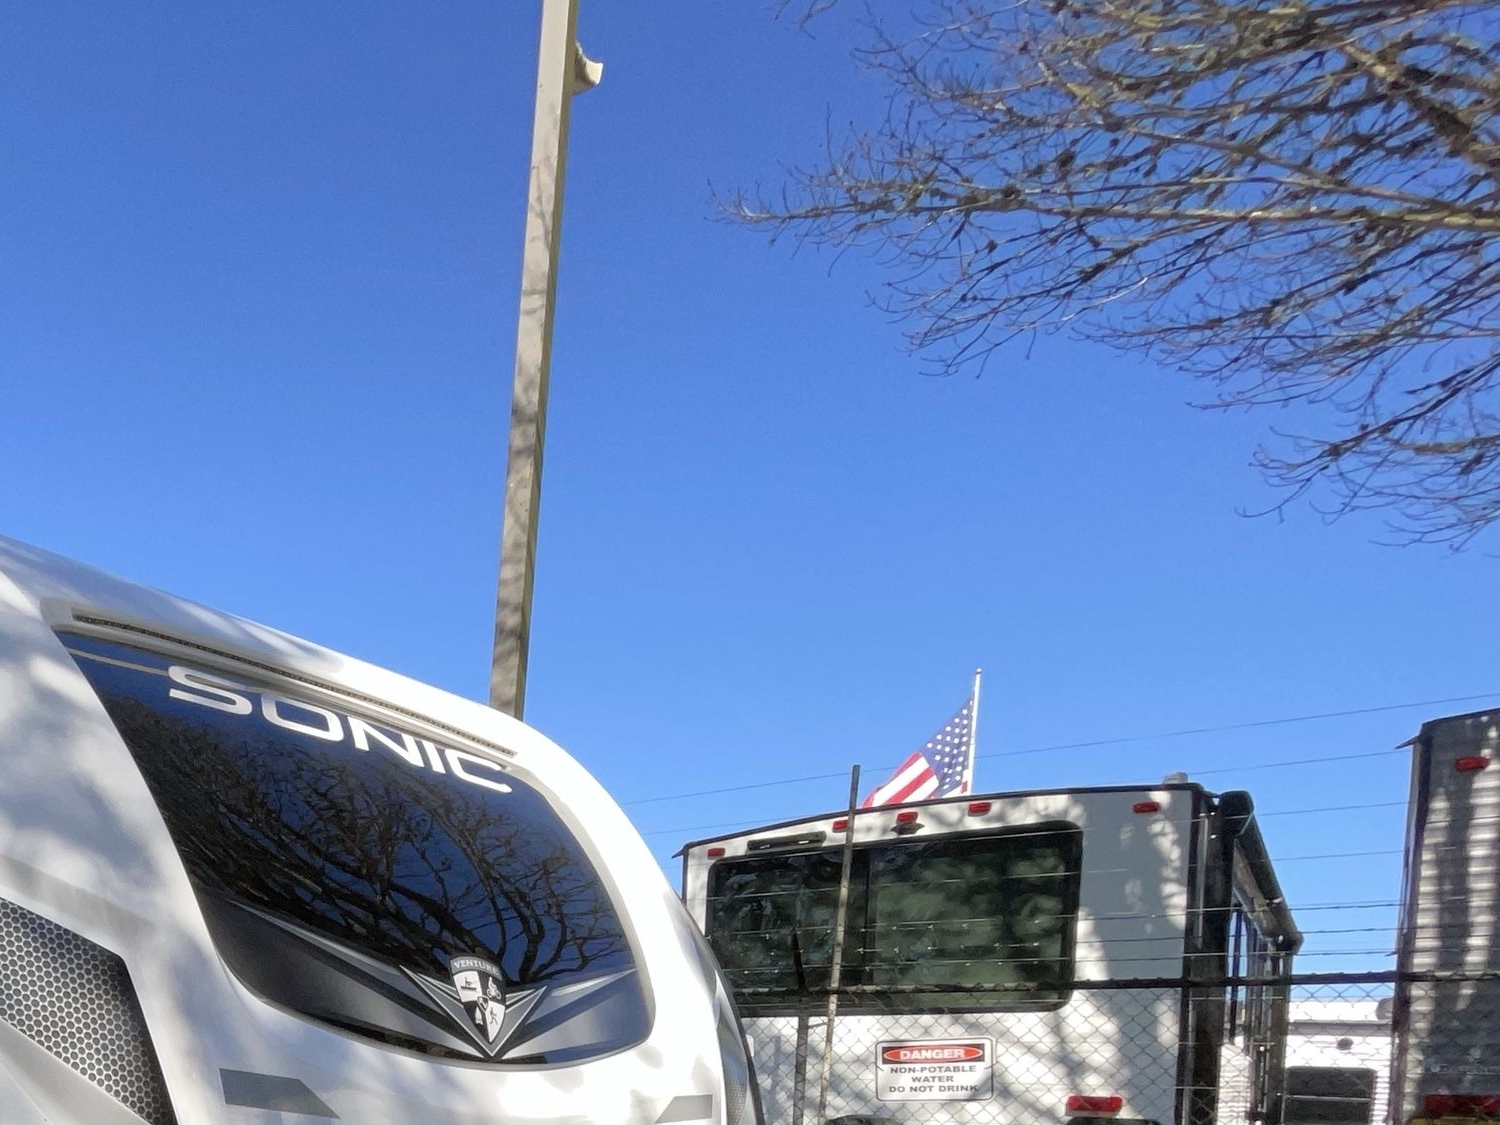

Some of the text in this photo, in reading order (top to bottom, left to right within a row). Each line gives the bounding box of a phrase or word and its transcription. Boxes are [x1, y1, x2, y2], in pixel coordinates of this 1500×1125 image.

[168, 665, 512, 793] SONIC
[454, 959, 500, 976] VENTURE
[899, 1049, 965, 1060] DANGER
[890, 1065, 977, 1074] NON-POTABLE
[911, 1075, 955, 1083] WATER
[910, 1085, 934, 1093] NOT
[938, 1085, 979, 1093] DRINK
